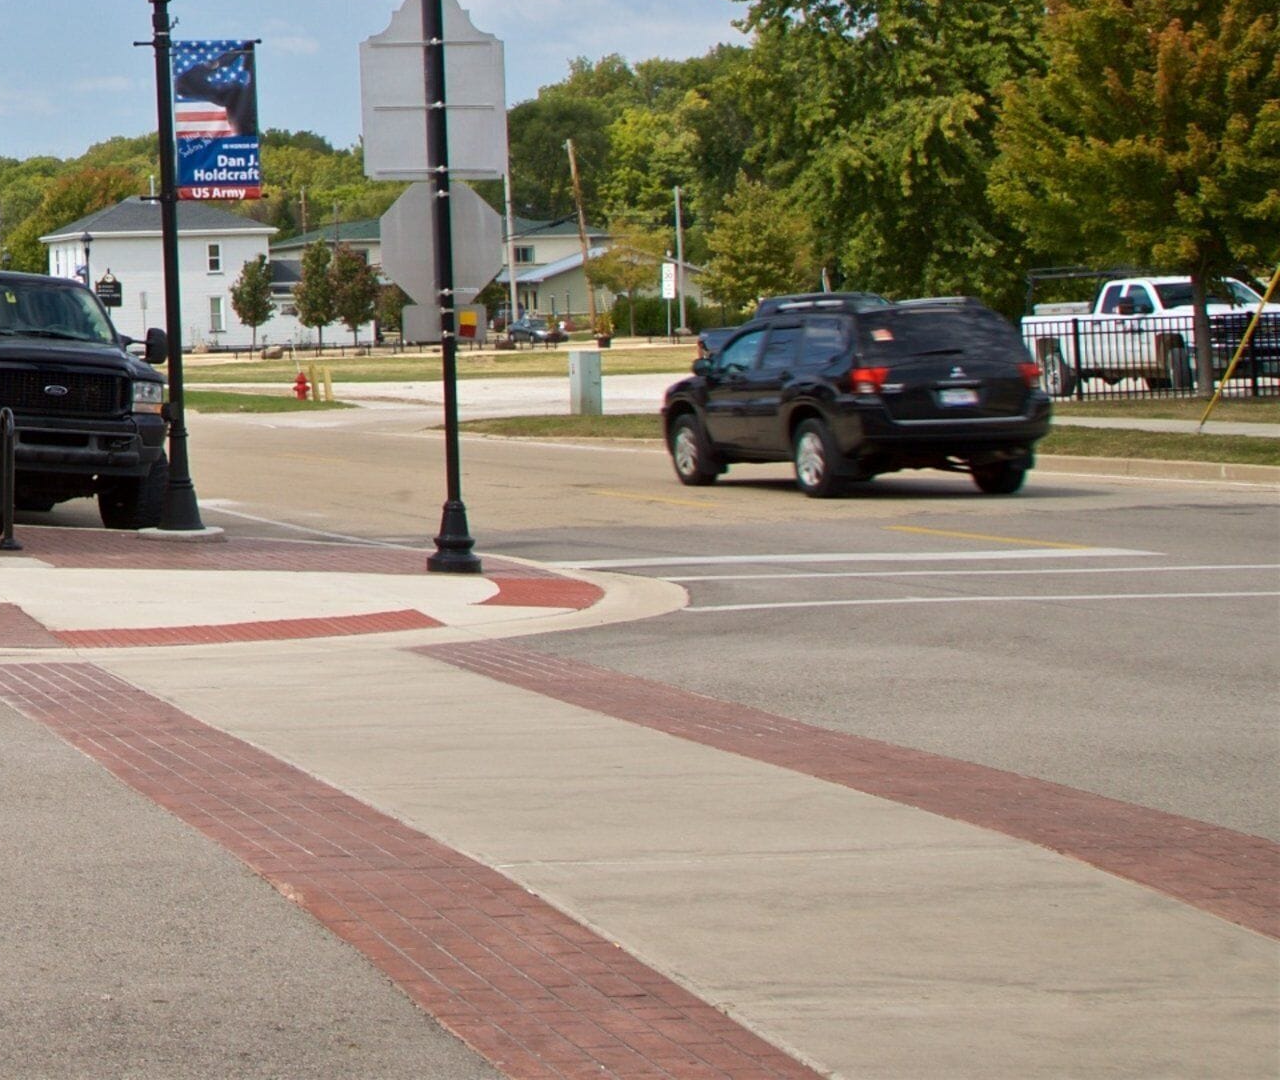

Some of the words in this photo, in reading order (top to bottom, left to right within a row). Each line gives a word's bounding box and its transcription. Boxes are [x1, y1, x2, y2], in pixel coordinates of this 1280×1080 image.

[217, 154, 245, 167] Dan
[247, 153, 259, 167] J.
[194, 168, 259, 181] Holdcraft
[192, 187, 210, 198] US
[212, 187, 246, 199] Army
